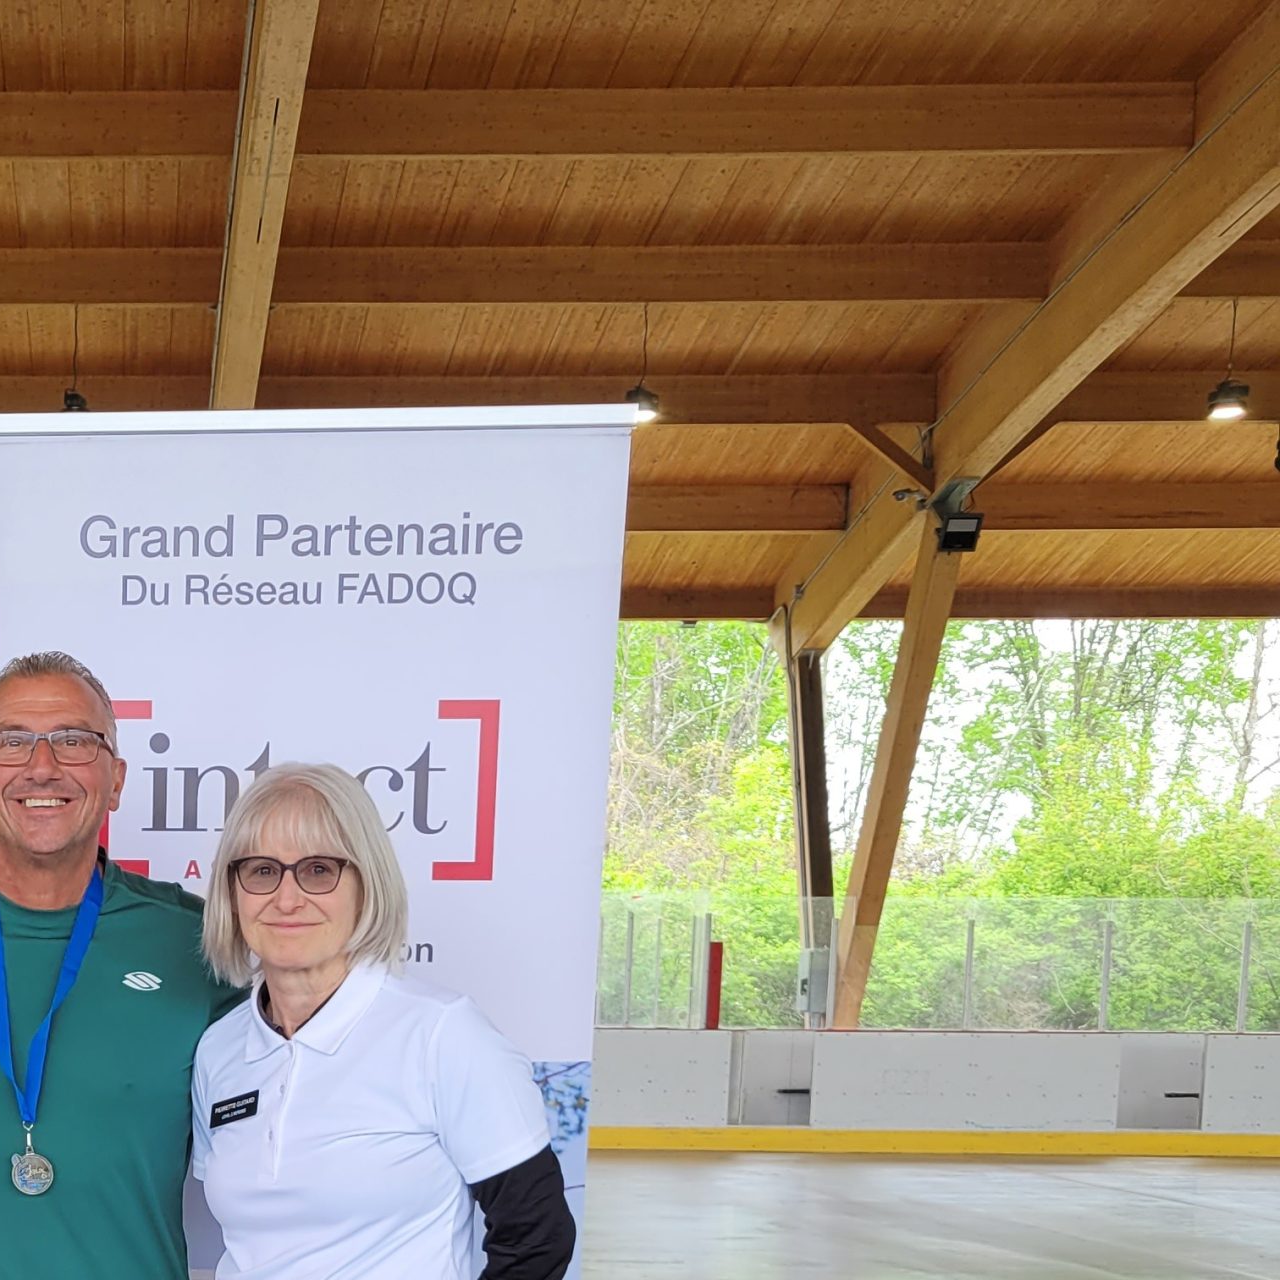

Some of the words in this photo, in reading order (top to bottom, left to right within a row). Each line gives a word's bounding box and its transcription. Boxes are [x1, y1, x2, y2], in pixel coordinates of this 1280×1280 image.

[79, 514, 234, 558] Grand
[255, 512, 523, 557] Partenaire
[121, 575, 169, 605] Du
[184, 573, 322, 605] Réseau
[337, 571, 477, 605] FADOQ
